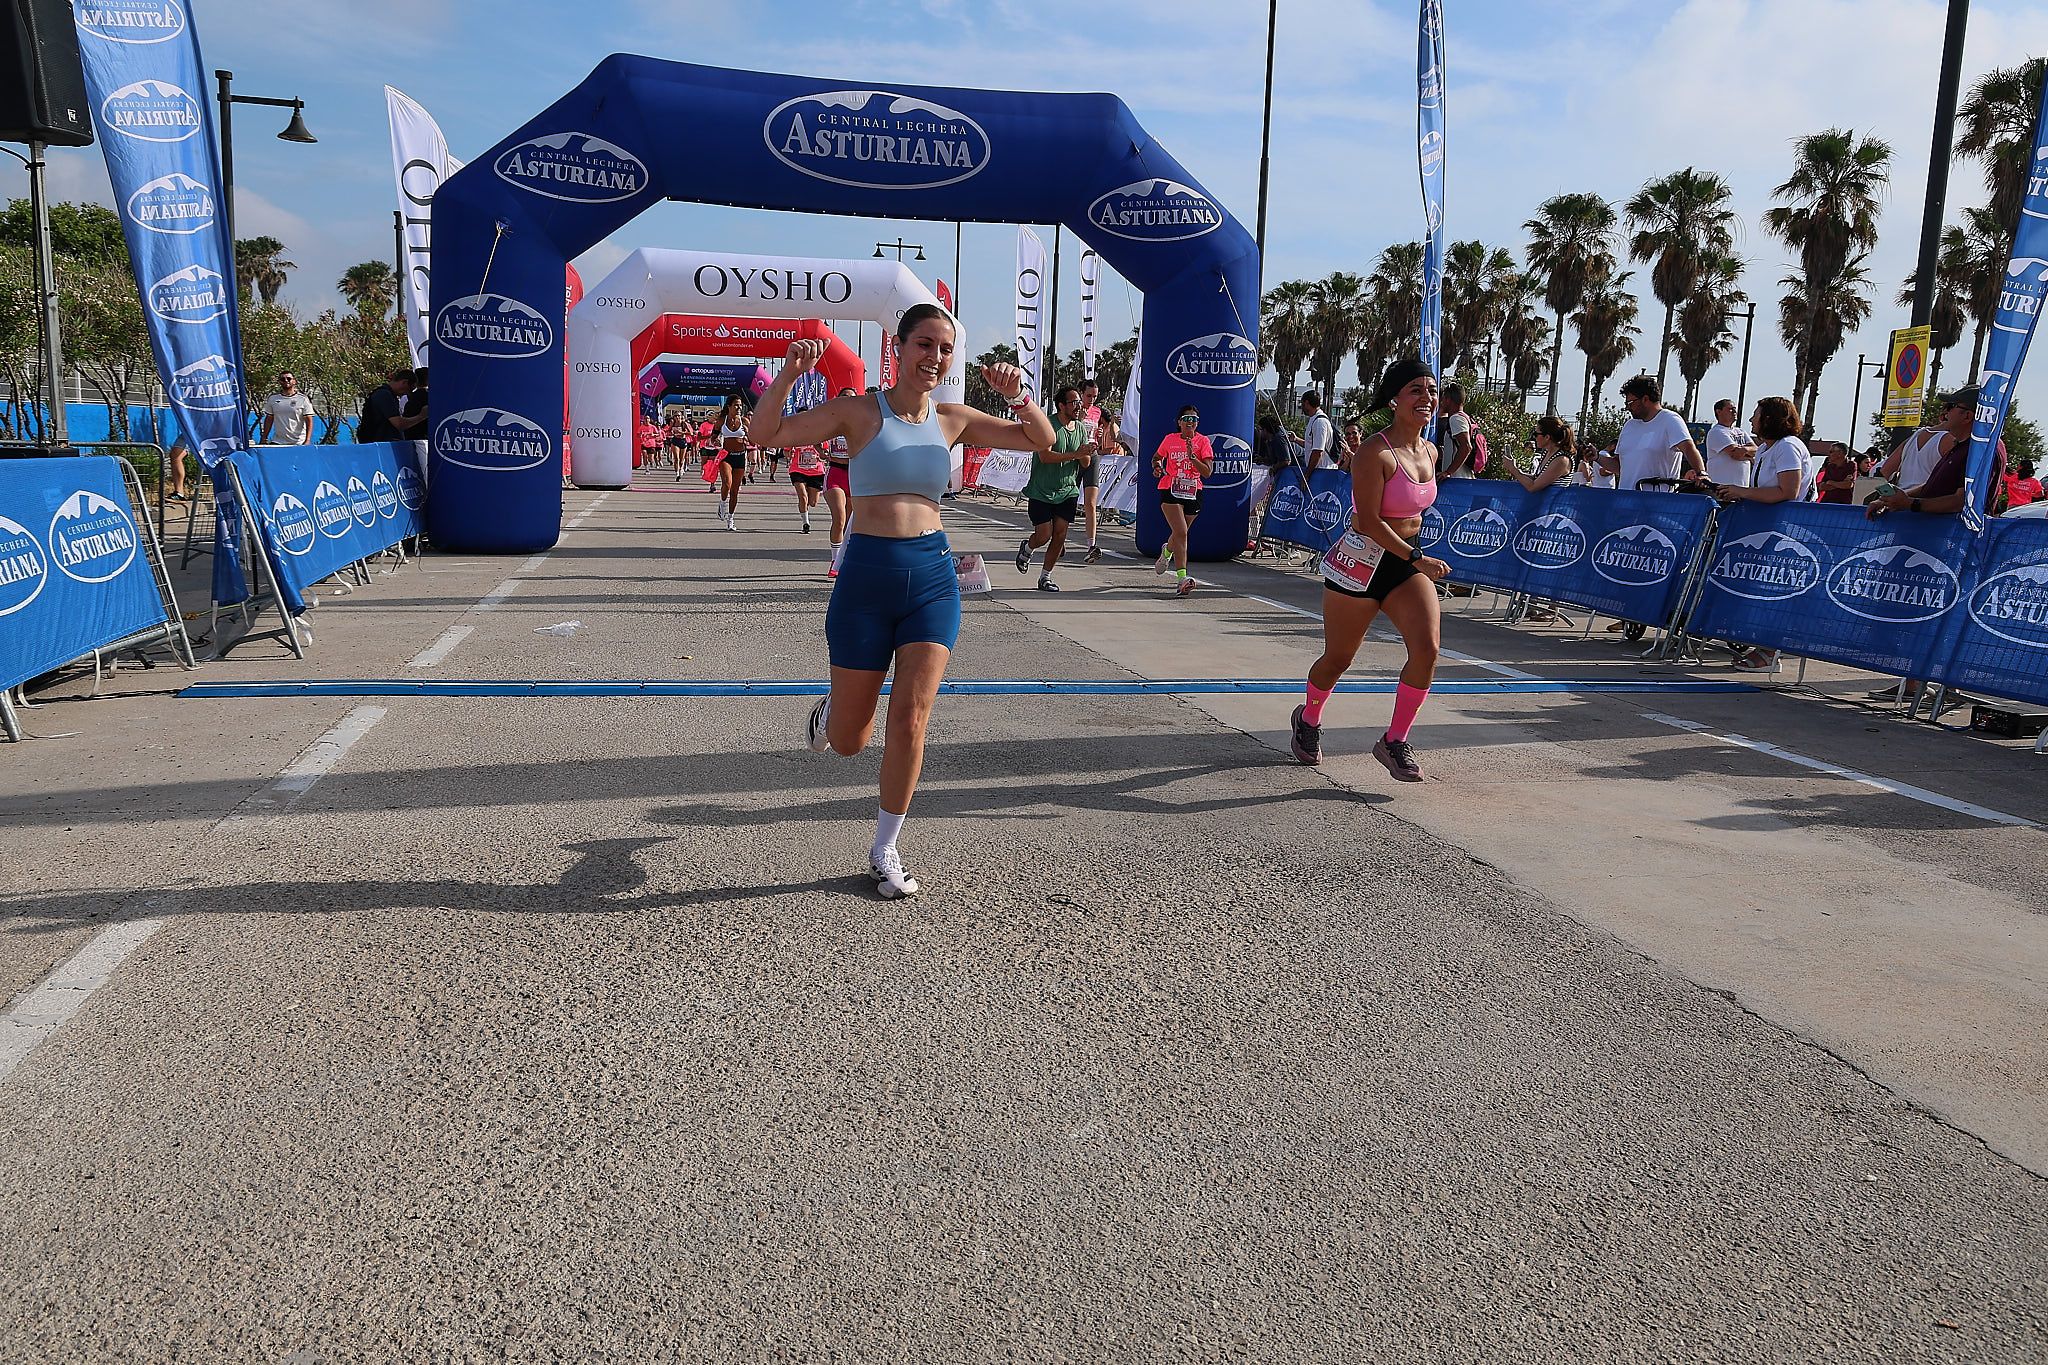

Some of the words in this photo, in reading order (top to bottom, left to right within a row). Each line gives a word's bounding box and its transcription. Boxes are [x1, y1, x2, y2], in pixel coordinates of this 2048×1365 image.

[818, 113, 889, 129] CENTRAL
[896, 120, 967, 135] LECHERA
[781, 112, 974, 168] ASTURIANA
[530, 151, 581, 163] CENTRAL
[586, 157, 635, 171] LECHERA
[503, 152, 636, 191] ASTURIANA
[1099, 202, 1217, 226] ASTURIANA
[1120, 200, 1166, 208] CENTRAL
[693, 264, 852, 304] OYSHO
[596, 296, 646, 310] OYSHO
[440, 314, 547, 347] ASTURIANA
[455, 313, 498, 322] CENTRAL
[502, 316, 544, 328] LECHERA
[672, 324, 712, 339] Sports
[732, 327, 796, 340] Santander
[575, 362, 622, 374] OYSHO
[440, 427, 544, 458] ASTURIANA
[455, 426, 496, 436] CENTRAL
[500, 430, 542, 440] LECHERA
[576, 427, 622, 439] OYSHO
[1211, 459, 1250, 474] RIANA
[68, 522, 95, 536] CENTRAL
[1450, 524, 1502, 547] ASTURIANA
[0, 538, 30, 553] ECHERA
[1516, 530, 1578, 559] ASTURIANA
[1336, 552, 1356, 568] 016
[1596, 542, 1668, 576] ASTURIANA
[1712, 552, 1808, 588] ASTURIANA
[1903, 574, 1947, 585] LECHERA
[1832, 566, 1946, 609] ASTURIANA
